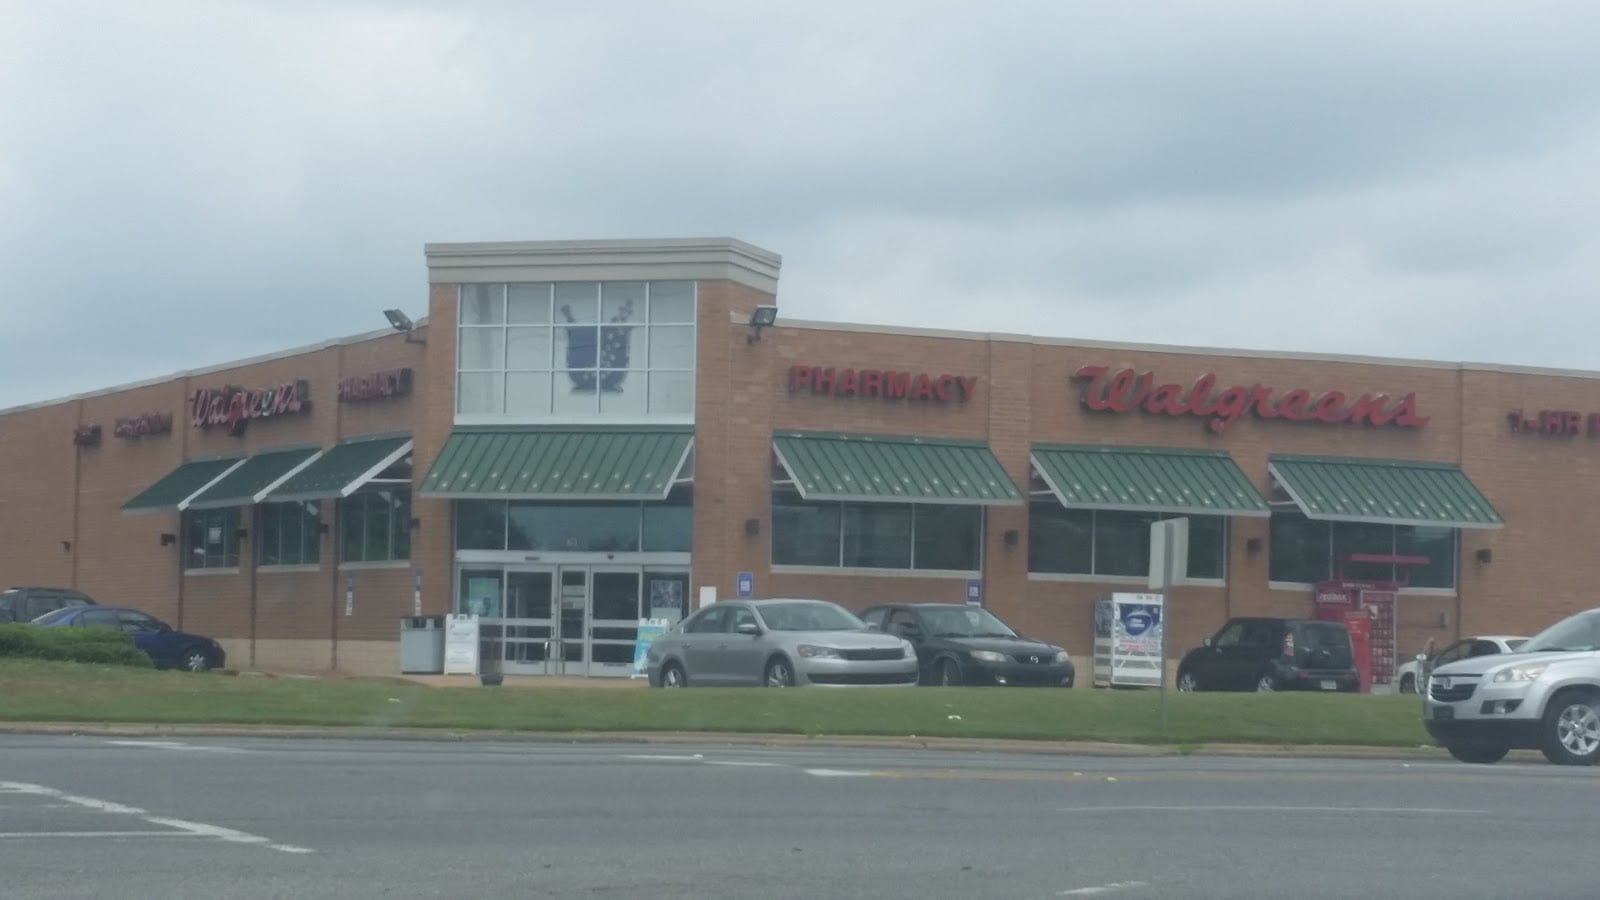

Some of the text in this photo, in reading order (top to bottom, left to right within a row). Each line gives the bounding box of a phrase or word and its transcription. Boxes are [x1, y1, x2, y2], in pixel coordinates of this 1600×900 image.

[189, 379, 310, 436] Walgreens
[788, 365, 978, 404] PHARMACY
[1071, 365, 1430, 433] Walgreens
